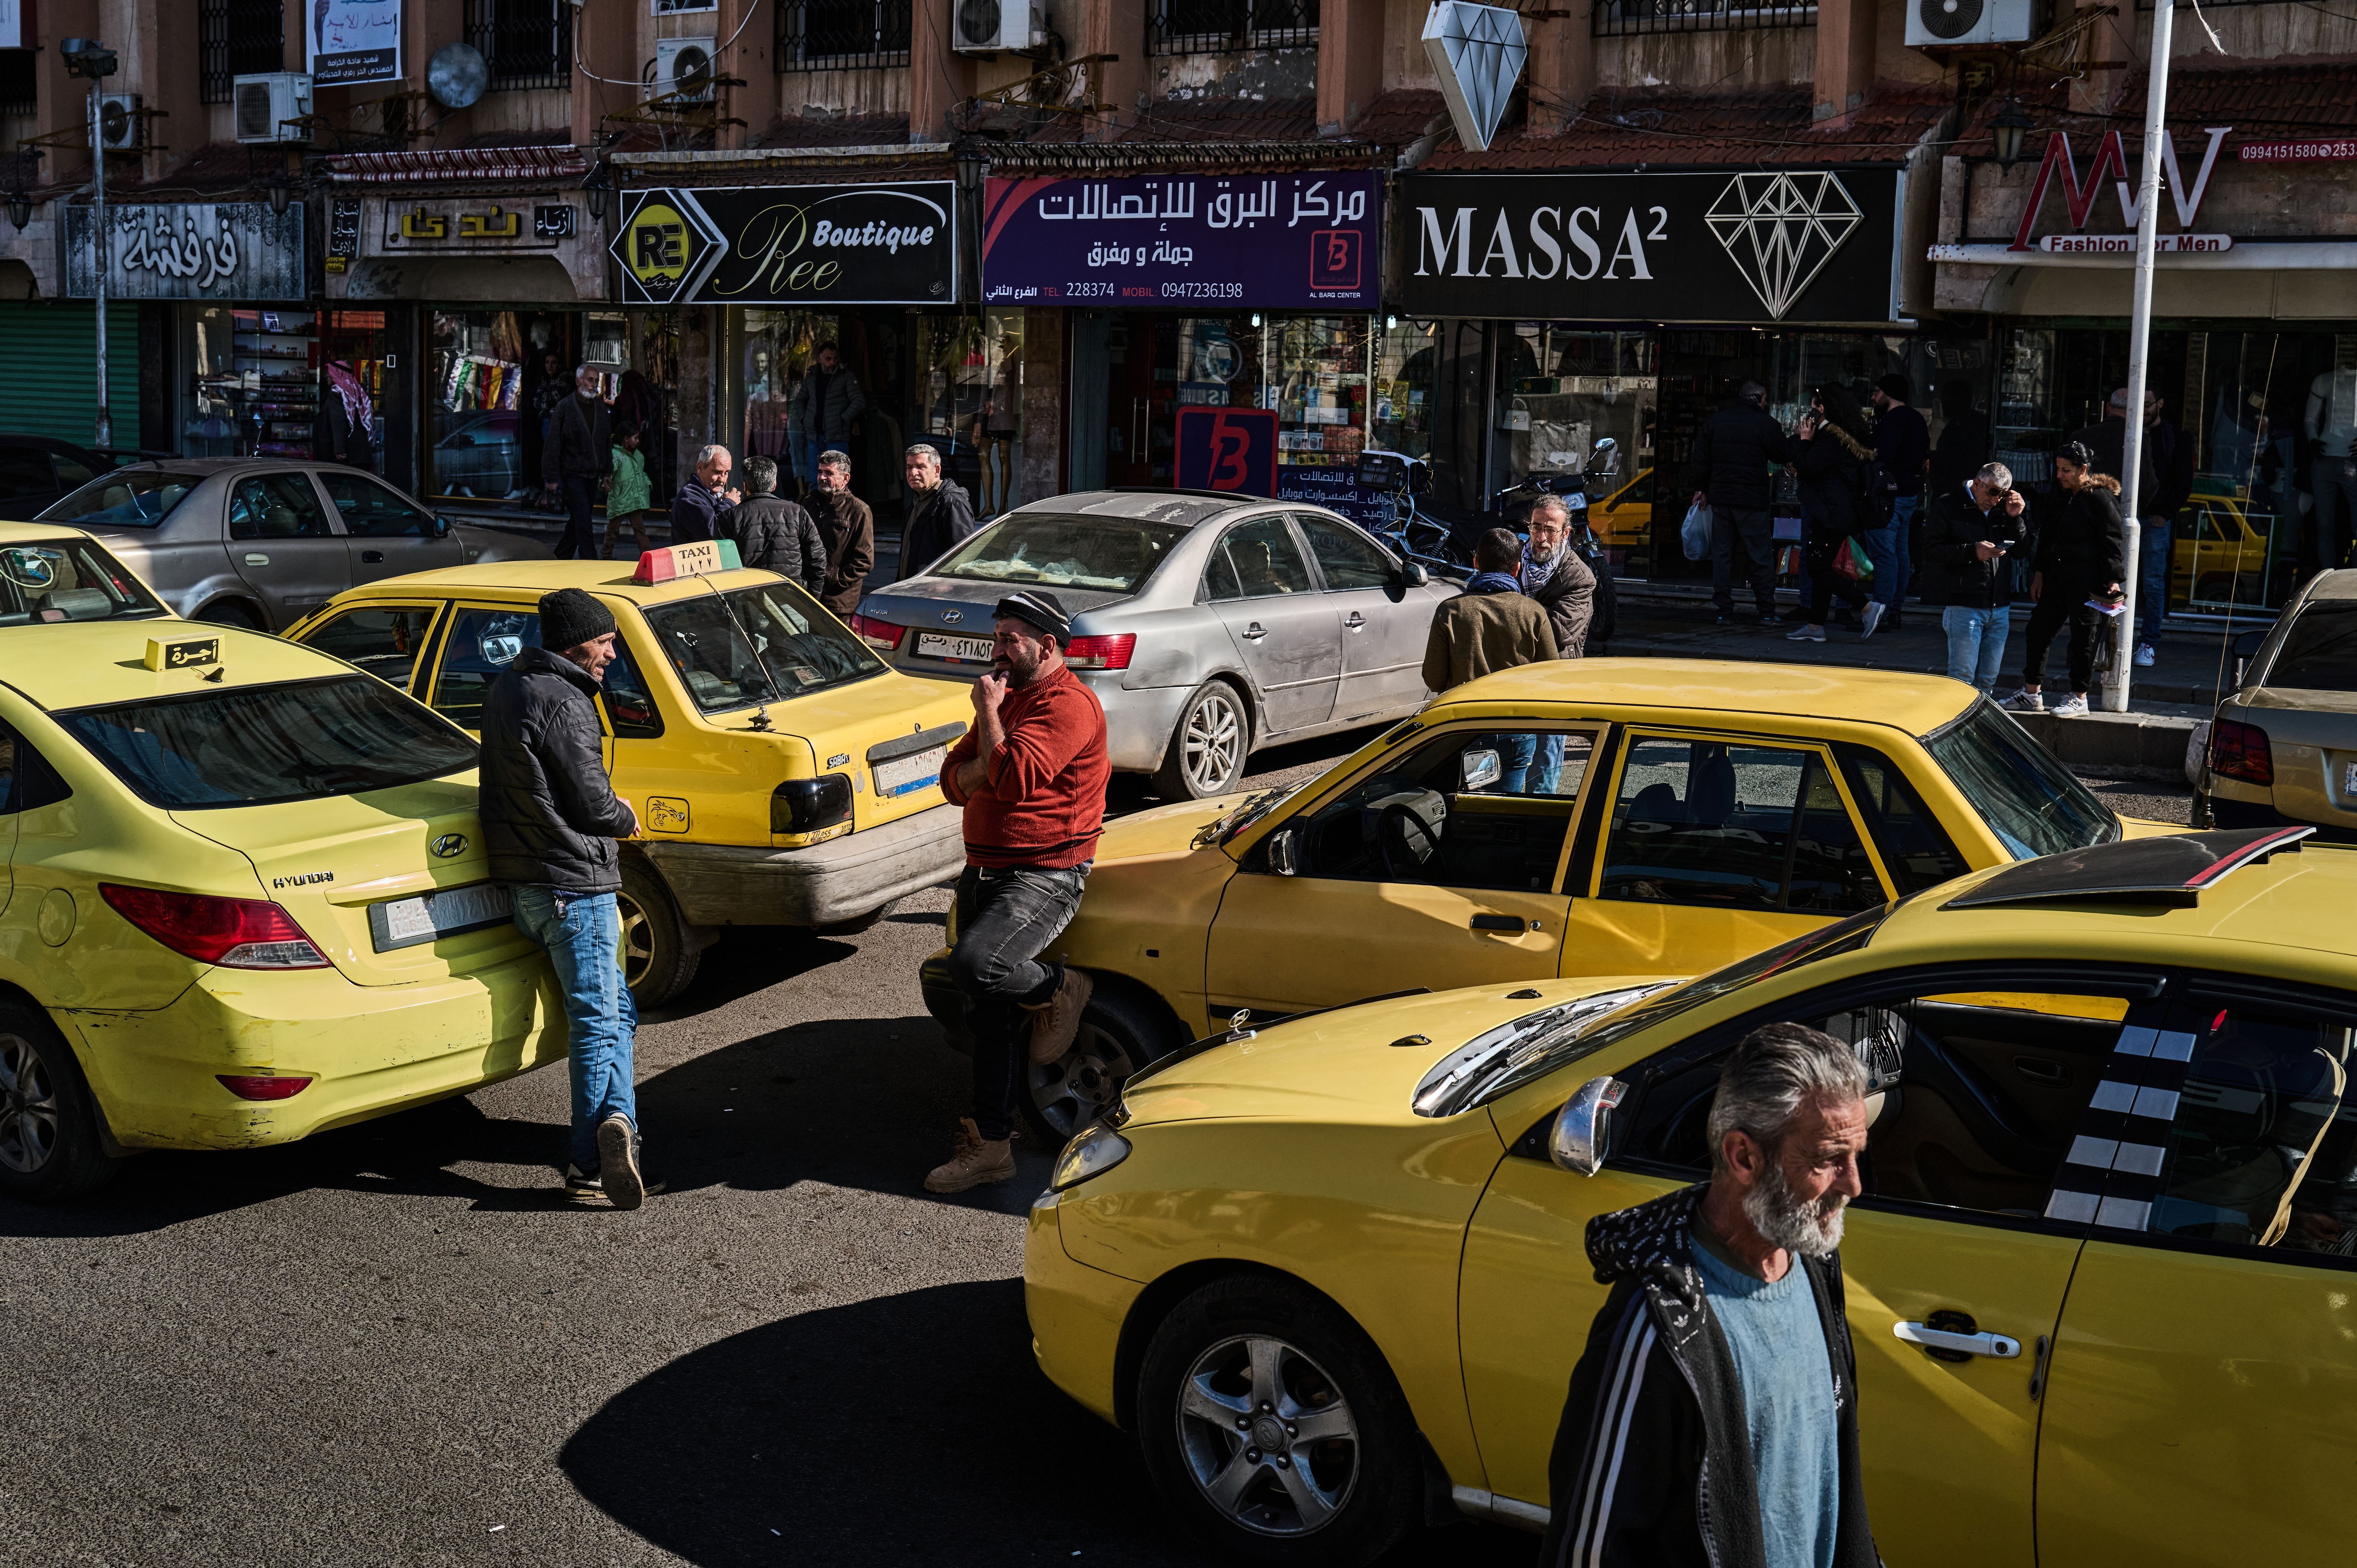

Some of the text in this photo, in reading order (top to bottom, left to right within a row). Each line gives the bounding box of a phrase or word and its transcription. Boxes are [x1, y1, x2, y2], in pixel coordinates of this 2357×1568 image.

[328, 59, 345, 67] الكرامة
[363, 54, 379, 63] شهيد
[357, 68, 366, 76] الحر
[368, 65, 393, 75] المهندس
[2243, 143, 2357, 159] 0994151580 253
[1039, 181, 1365, 231] مركز البرق للإتصالات
[537, 208, 571, 235] أزياء
[812, 220, 935, 255] Boutique
[2051, 236, 2128, 251] Fashion
[2177, 236, 2219, 251] Men
[122, 215, 238, 288] فرفشة
[636, 223, 683, 269] RE
[713, 204, 843, 294] Ree
[1088, 240, 1193, 267] جملة و مفرق
[643, 274, 678, 289] بوتيك
[986, 286, 1037, 301] الفرع الثاني
[1043, 282, 1114, 297] TEL: 228374
[1122, 283, 1243, 298] MOBIL: 0947236198
[1300, 471, 1344, 485] للإتصالات
[1277, 488, 1303, 500] موبايل
[679, 546, 711, 559] TAXI
[682, 558, 711, 574] ١٨٢٧
[922, 635, 947, 646] دمشق
[172, 640, 217, 665] أجرة
[827, 753, 845, 770] SABA
[273, 871, 334, 888] HYUNDAI
